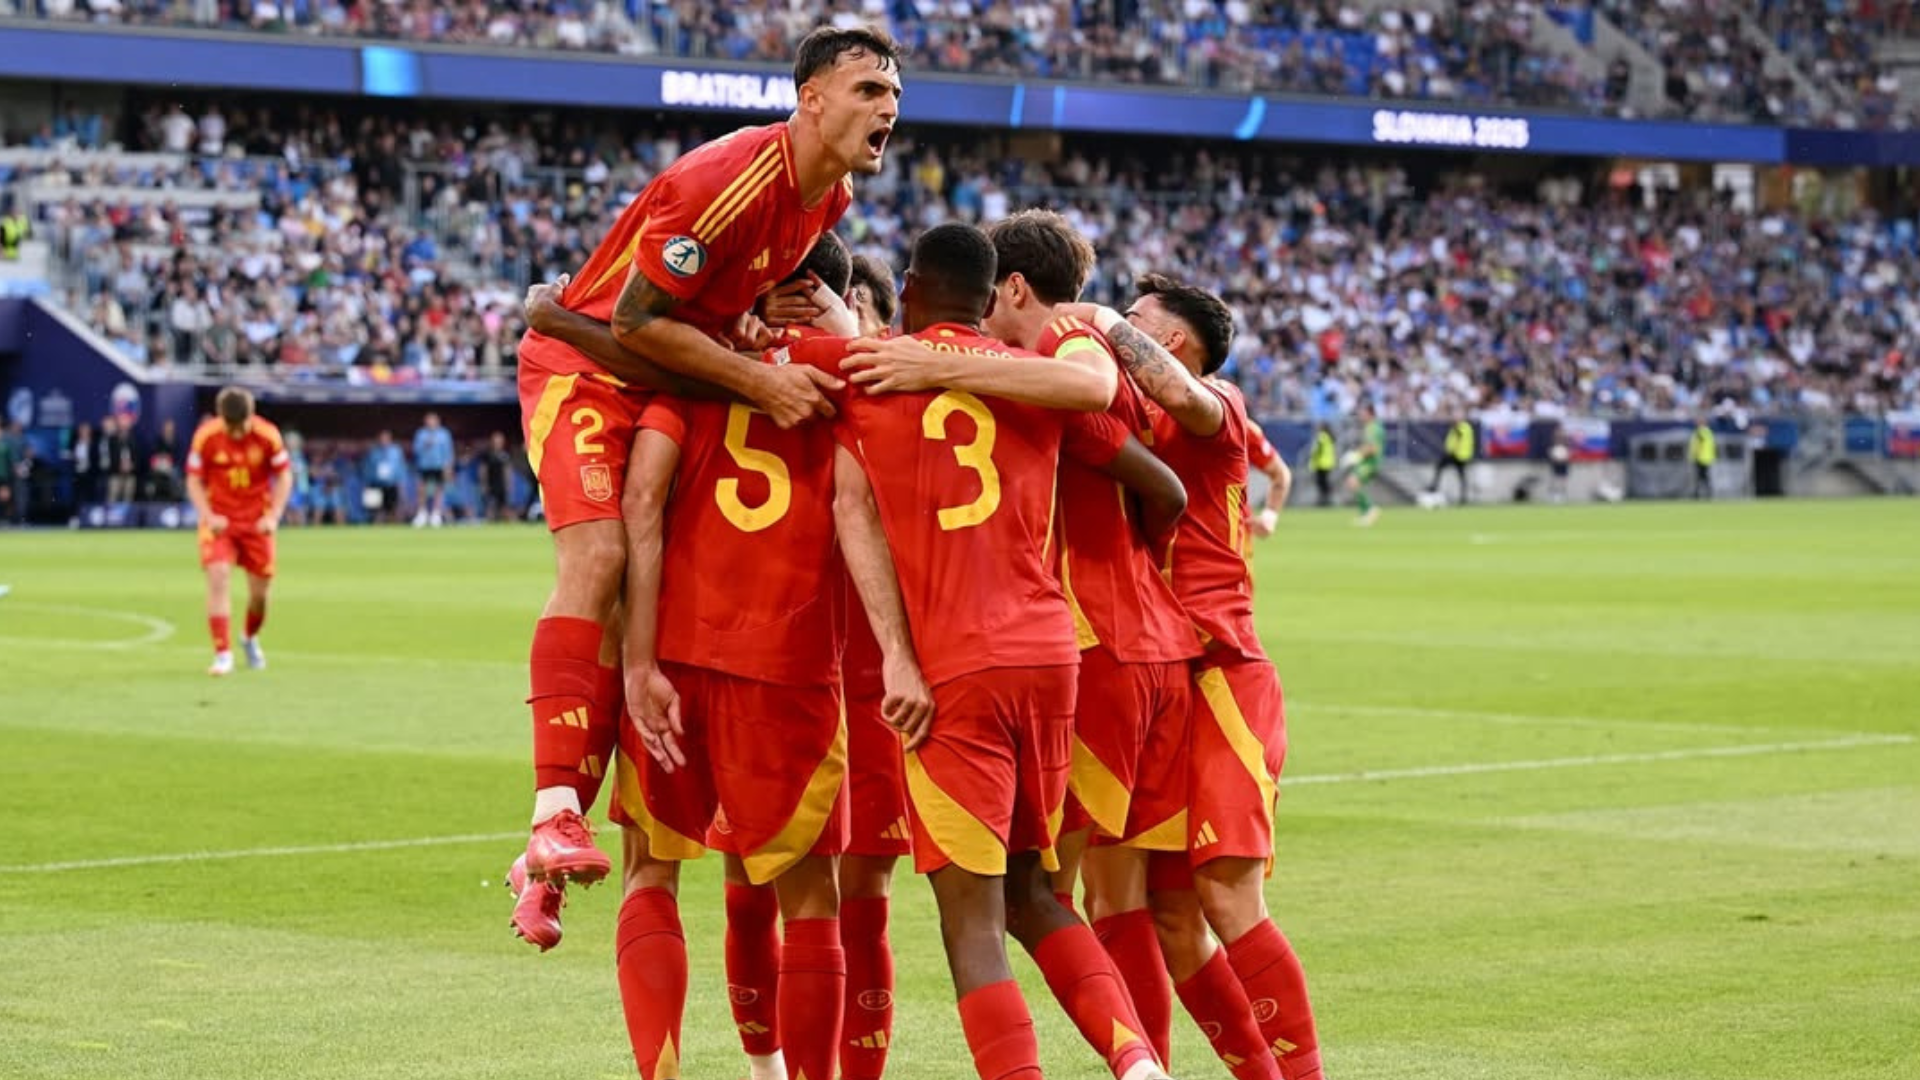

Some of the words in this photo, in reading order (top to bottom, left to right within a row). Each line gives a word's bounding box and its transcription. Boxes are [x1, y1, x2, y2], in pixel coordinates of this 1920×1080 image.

[662, 70, 798, 109] BRATISLAV
[1373, 110, 1473, 144] SLOVAKIA
[1475, 117, 1529, 148] 2025
[571, 407, 605, 455] 2
[715, 402, 792, 532] 5
[922, 389, 1001, 531] 3
